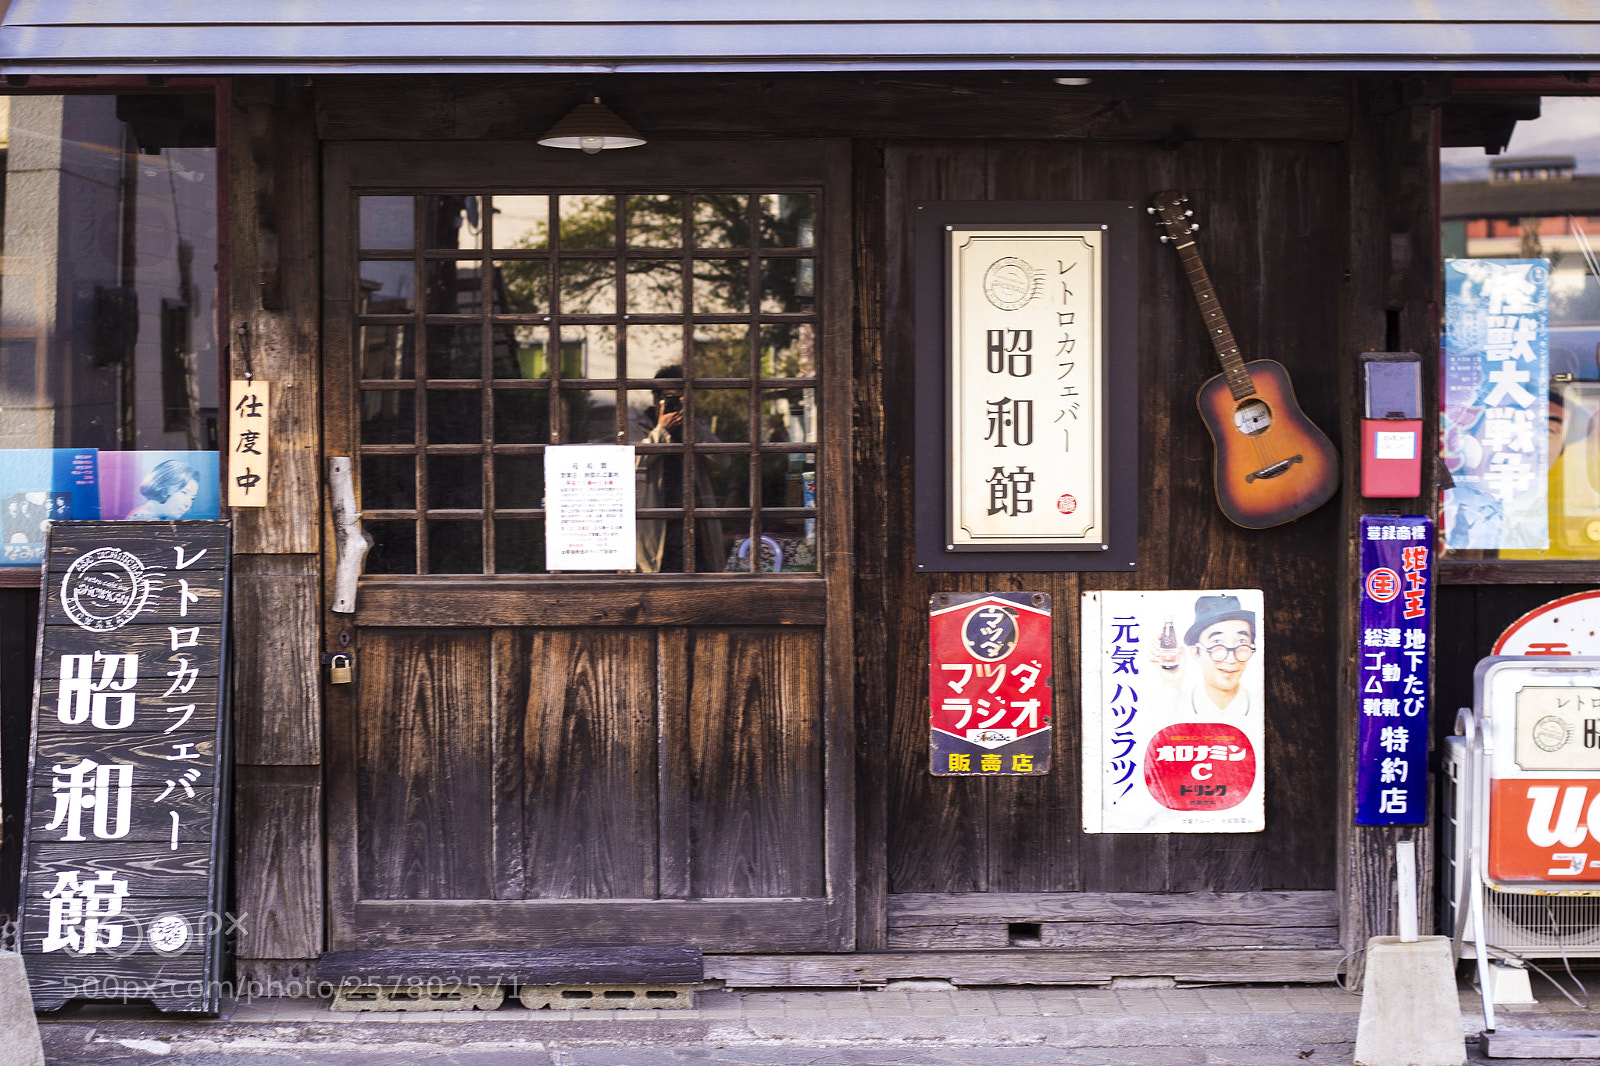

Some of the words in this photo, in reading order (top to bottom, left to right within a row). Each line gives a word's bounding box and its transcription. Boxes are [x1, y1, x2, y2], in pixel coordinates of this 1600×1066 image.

[1054, 259, 1081, 453] レトロカフェバー
[235, 394, 264, 496] 仕度中
[984, 327, 1036, 517] 昭和館
[941, 659, 1043, 694] マツダ
[979, 609, 1004, 658] マツダ
[1403, 628, 1427, 717] 地下たび
[155, 545, 207, 851] レトロカフェバー
[941, 696, 1041, 730] ラジオ
[1156, 745, 1247, 762] オロナミン
[1180, 785, 1227, 796] ドリンク
[1191, 763, 1213, 780] C
[1379, 726, 1409, 814] 特約店
[42, 650, 139, 955] 昭和館
